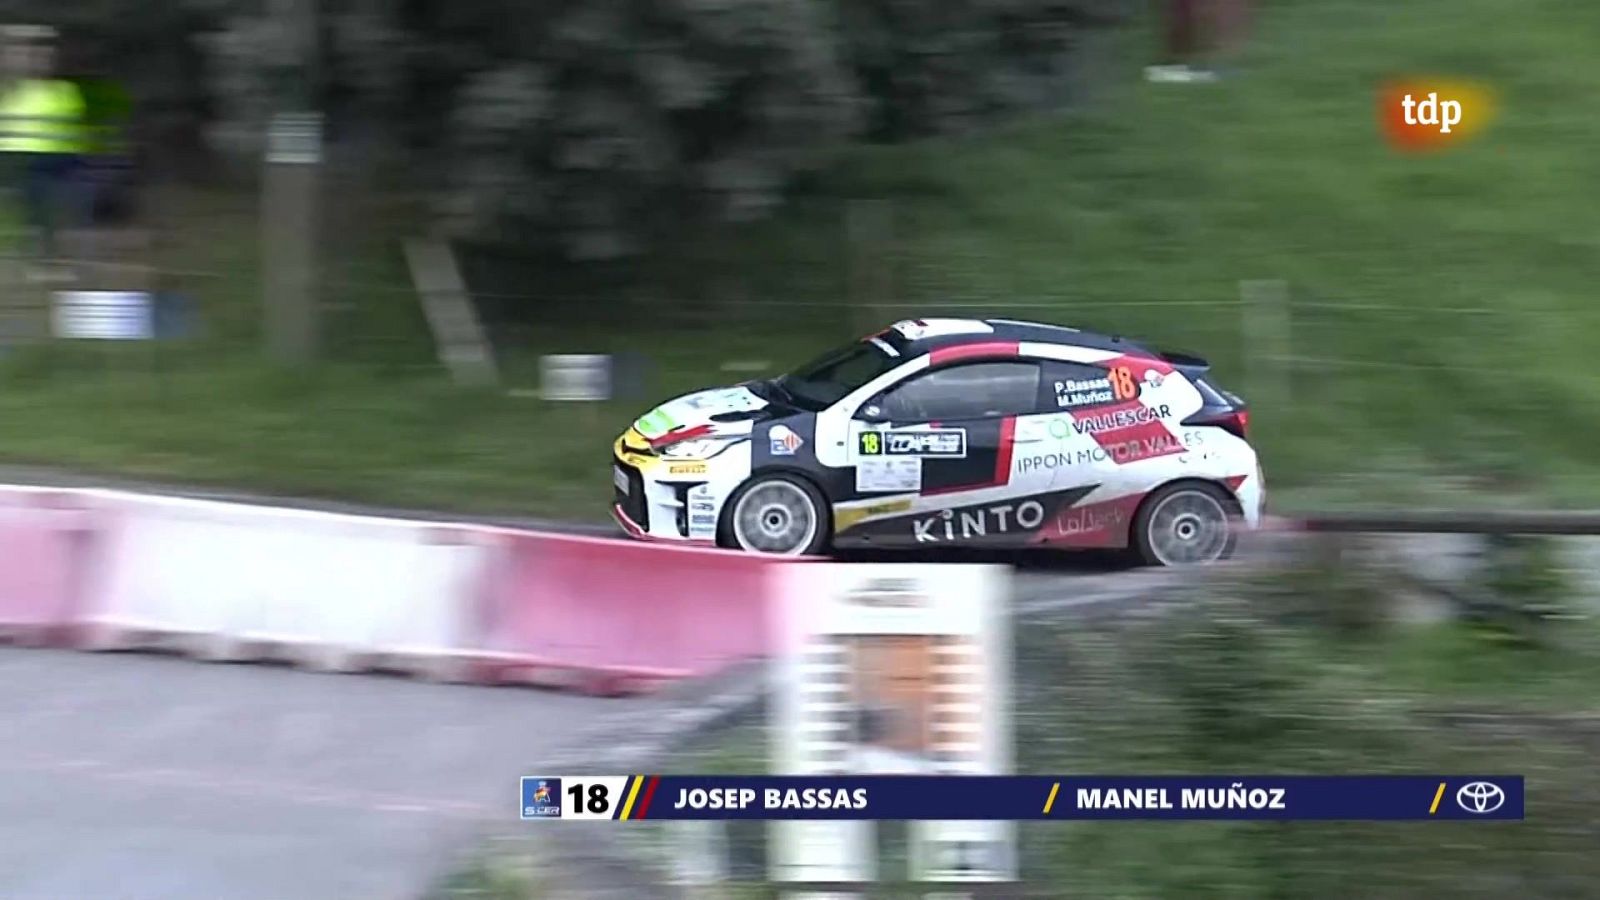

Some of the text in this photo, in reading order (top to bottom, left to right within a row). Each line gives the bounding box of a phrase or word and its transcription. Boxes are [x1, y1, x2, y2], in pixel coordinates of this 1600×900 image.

[1108, 366, 1136, 400] 18
[1072, 404, 1172, 435] VALLESCAR
[861, 433, 879, 453] 18
